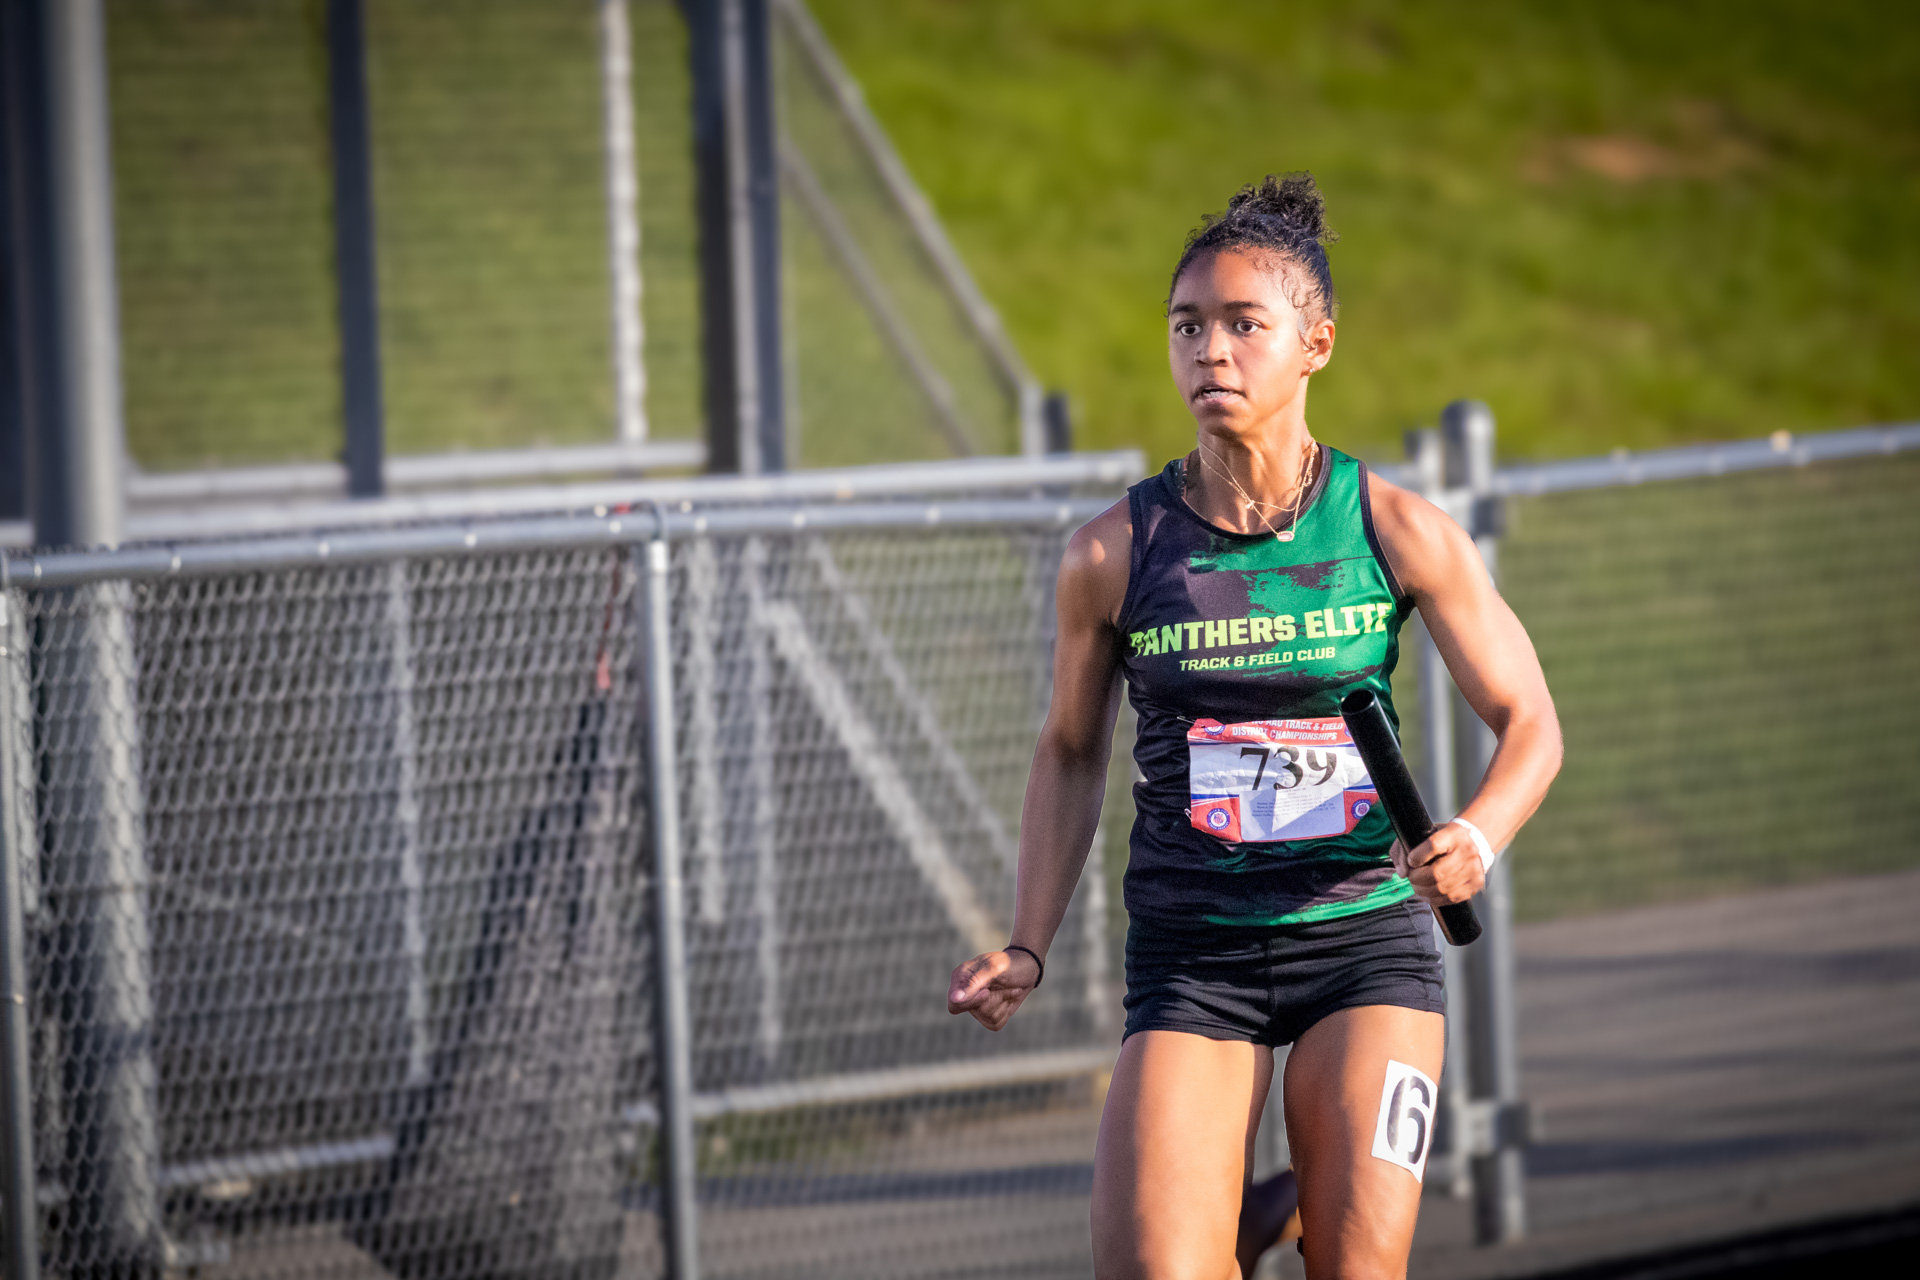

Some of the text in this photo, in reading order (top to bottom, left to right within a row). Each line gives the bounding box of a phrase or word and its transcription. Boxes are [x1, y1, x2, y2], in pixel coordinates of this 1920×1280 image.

[1129, 602, 1392, 657] PANTHERS ELITE
[1179, 646, 1336, 671] TRACK & FIELD CLUB
[1270, 729, 1337, 740] CHAMPIONSHIPS
[1286, 720, 1312, 730] TRACK
[1313, 722, 1320, 730] &
[1321, 722, 1343, 730] FIELD
[1240, 746, 1337, 791] 739
[1387, 1075, 1430, 1165] 6
